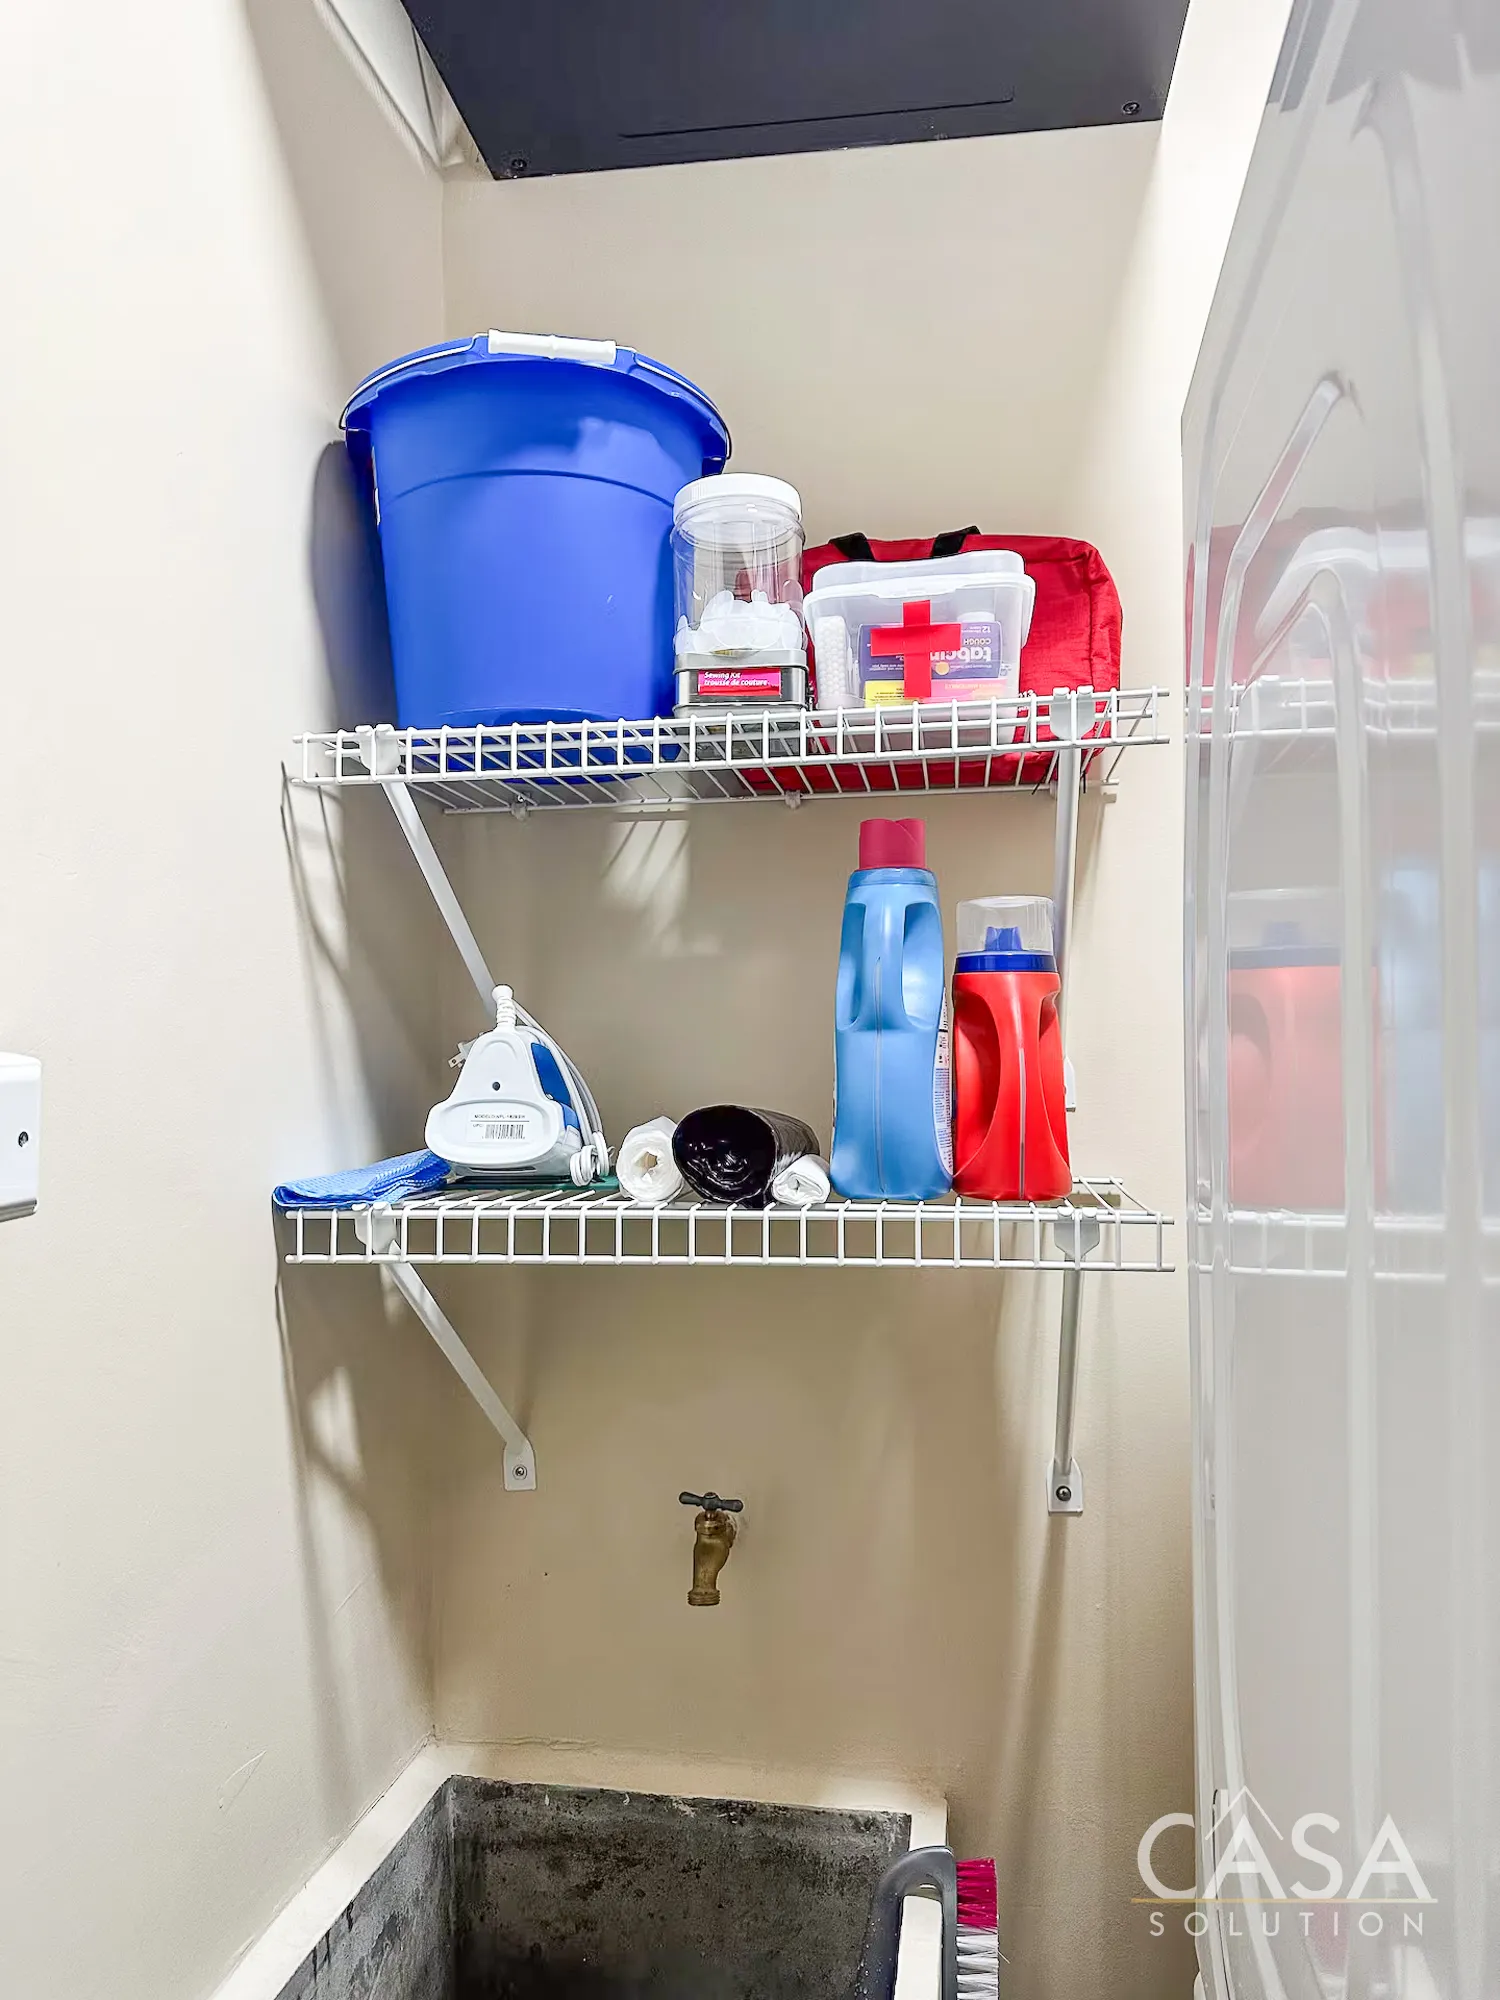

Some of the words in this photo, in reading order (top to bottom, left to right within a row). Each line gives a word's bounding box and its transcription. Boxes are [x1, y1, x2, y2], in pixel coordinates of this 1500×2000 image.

[963, 638, 992, 646] COUGH
[704, 672, 730, 680] Sewing
[730, 678, 741, 686] de
